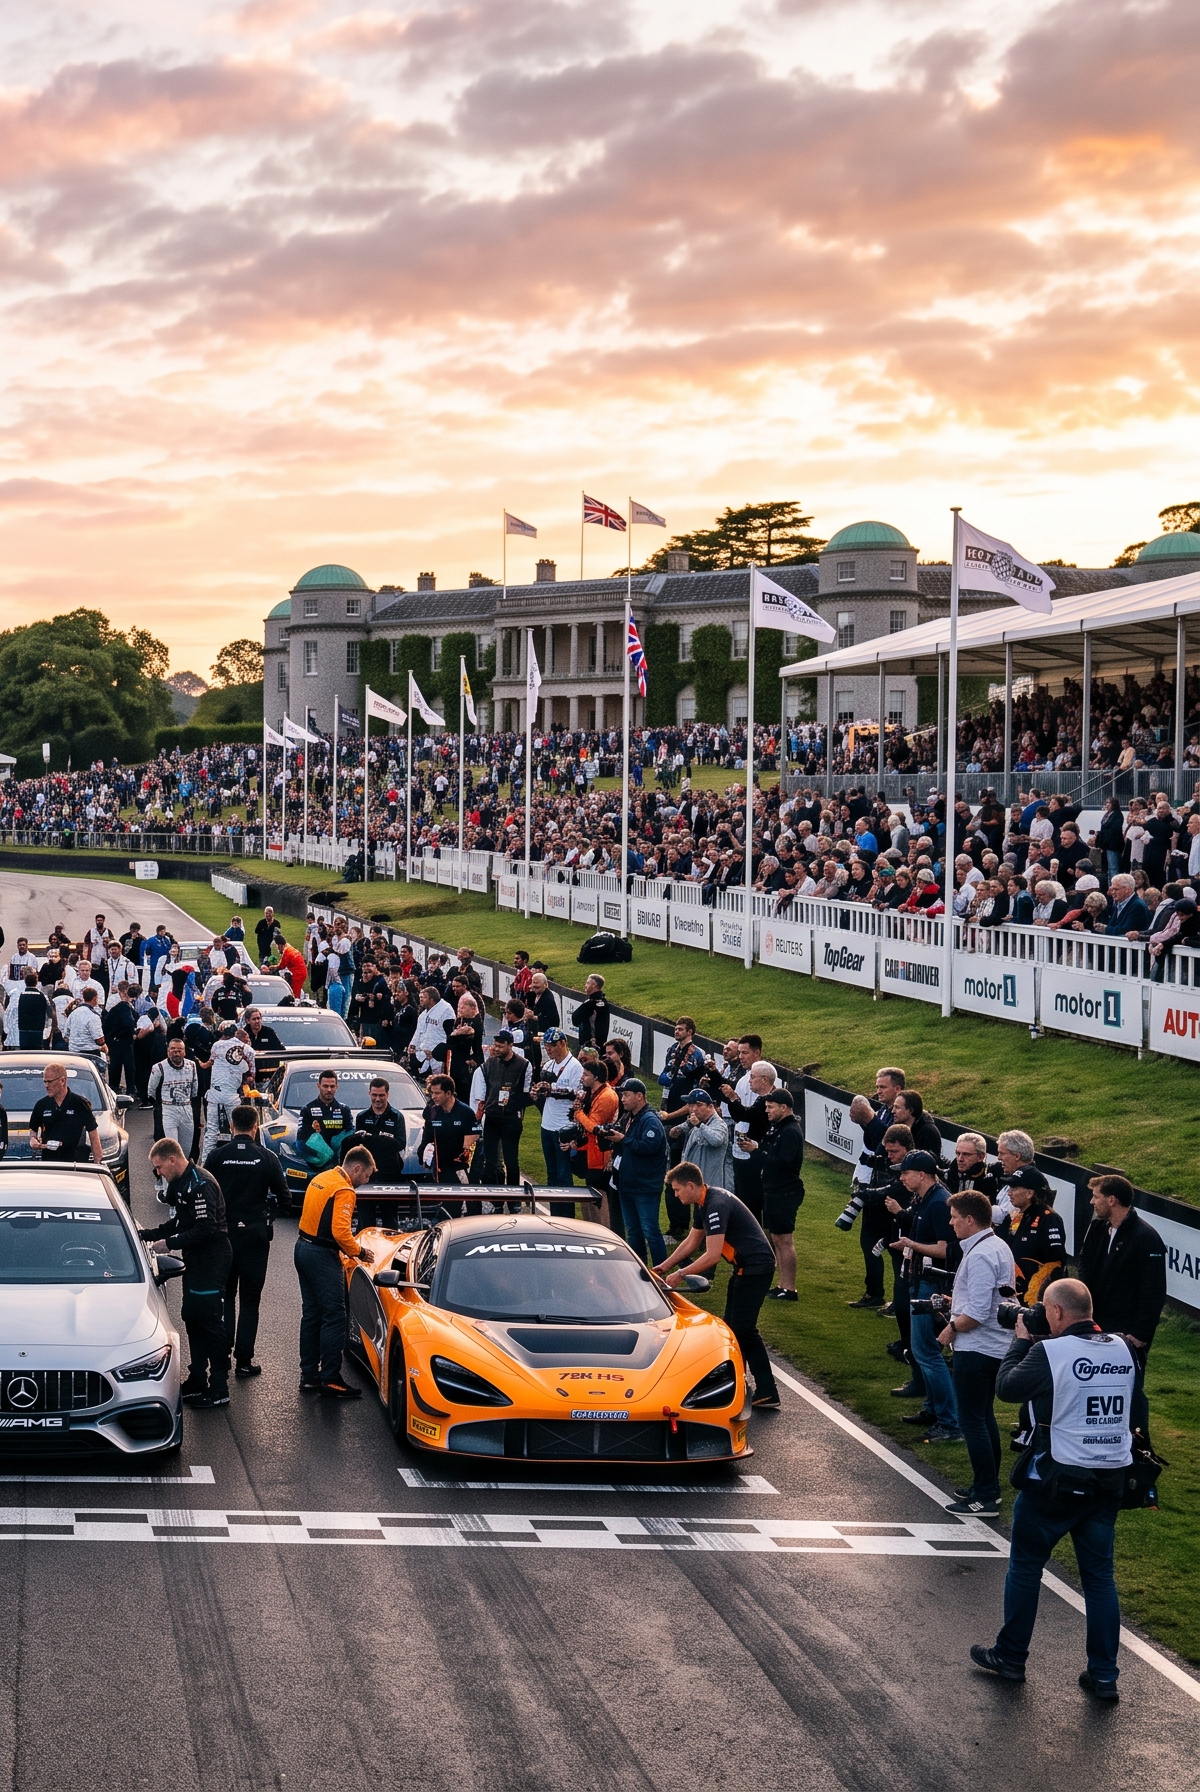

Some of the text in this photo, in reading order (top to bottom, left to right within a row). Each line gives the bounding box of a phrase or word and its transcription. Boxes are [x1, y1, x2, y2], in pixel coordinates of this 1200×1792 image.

[823, 942, 865, 972] TopGear
[1163, 1008, 1200, 1039] AUT
[464, 1243, 606, 1257] McLaren
[1076, 1361, 1133, 1378] TopGear
[1086, 1395, 1125, 1417] EVO
